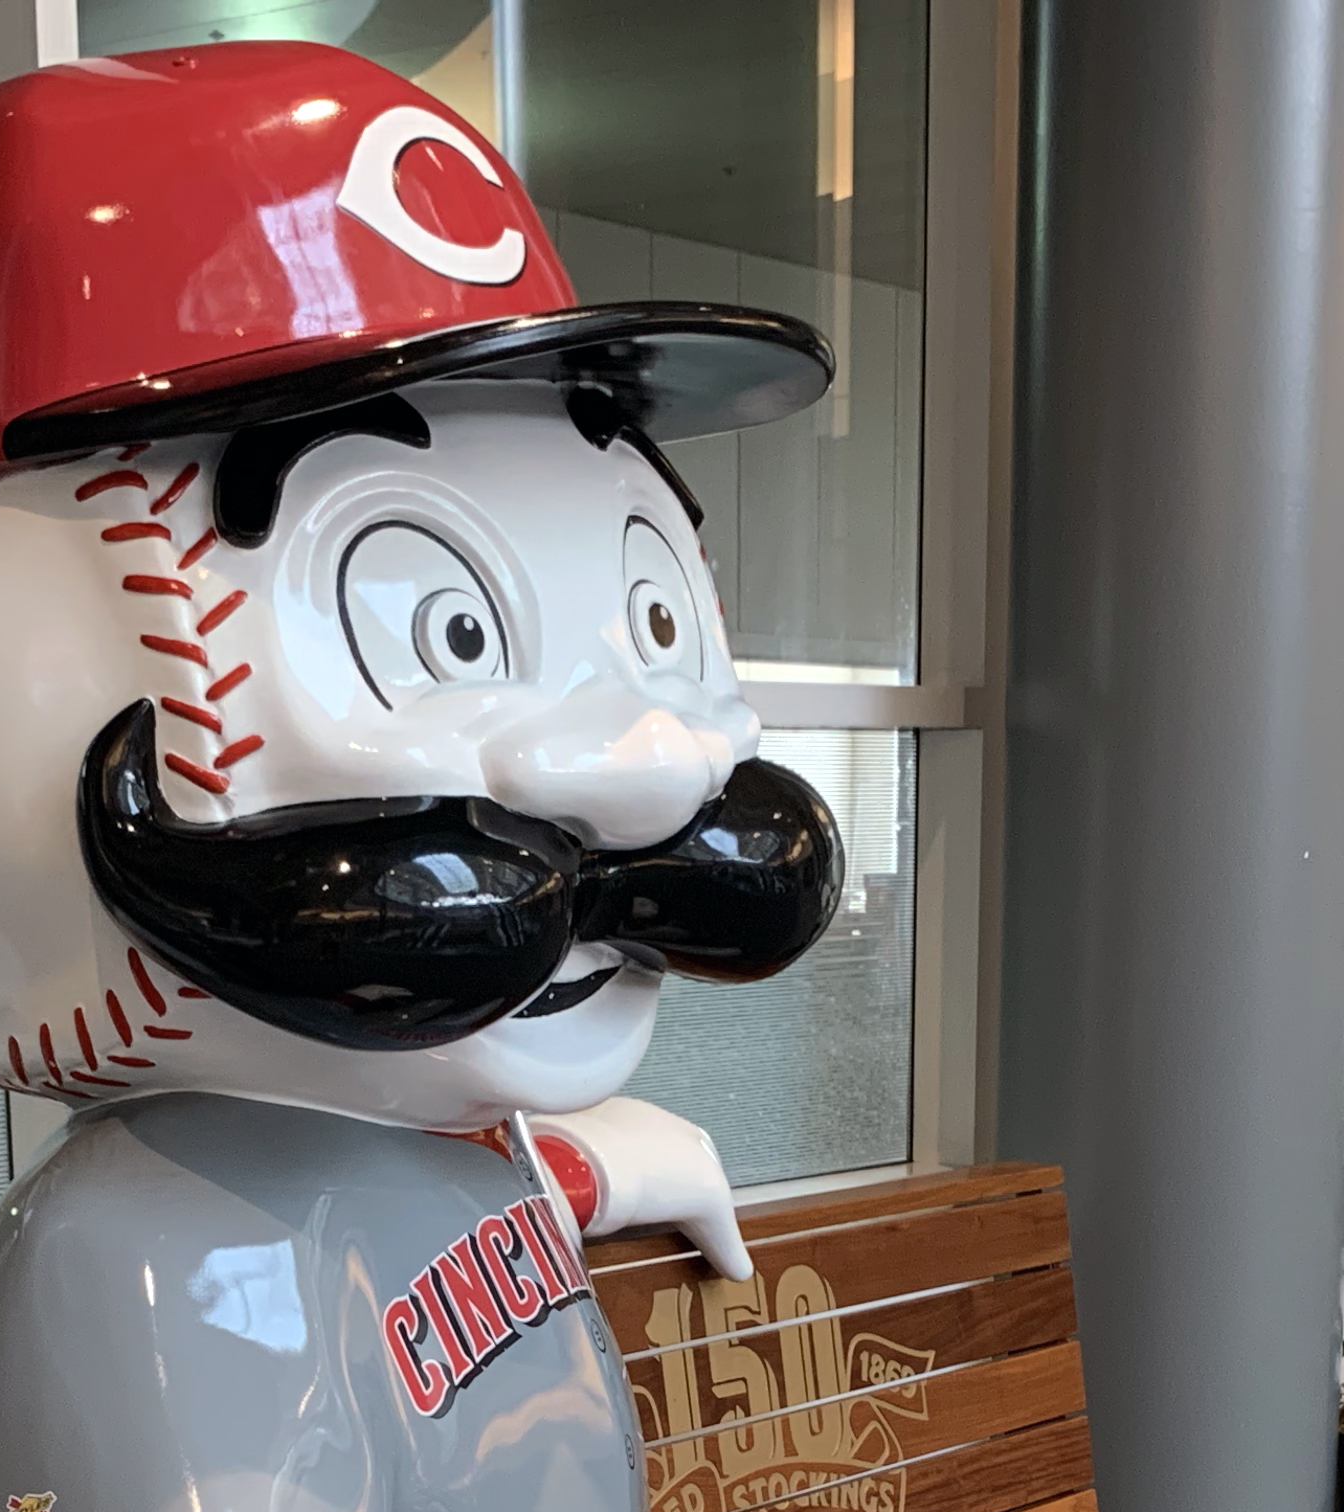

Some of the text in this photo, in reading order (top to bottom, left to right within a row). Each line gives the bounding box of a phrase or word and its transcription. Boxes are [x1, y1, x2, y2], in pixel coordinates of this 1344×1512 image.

[335, 104, 526, 286] C
[645, 1264, 850, 1478] 150
[859, 1350, 917, 1399] 1869
